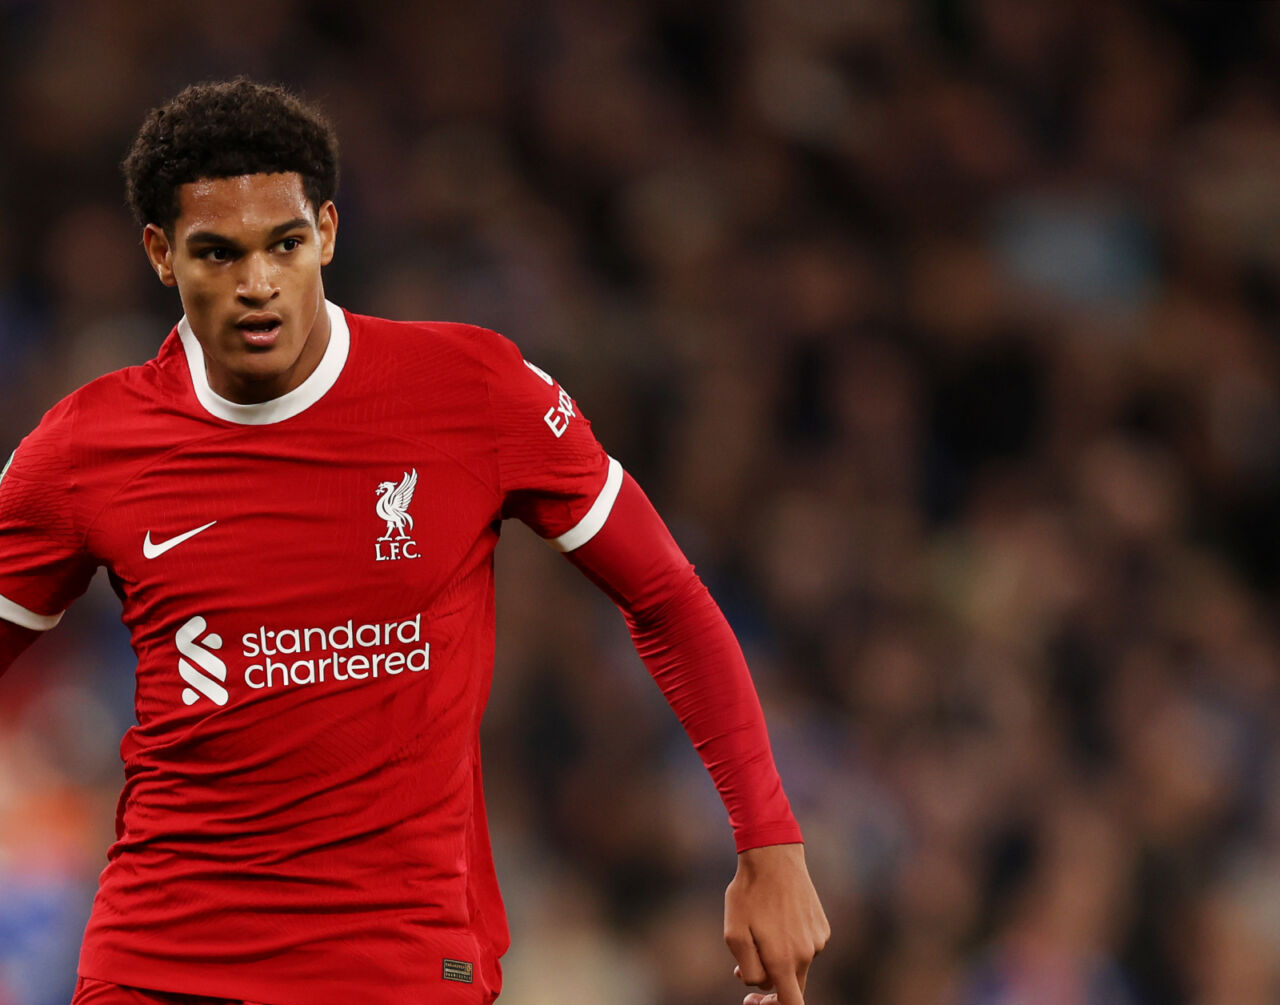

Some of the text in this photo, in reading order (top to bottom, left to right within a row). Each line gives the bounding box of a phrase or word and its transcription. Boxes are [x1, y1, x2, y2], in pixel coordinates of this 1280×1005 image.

[374, 540, 422, 562] L.F.C.
[241, 612, 421, 659] standard
[243, 641, 431, 690] chartered
